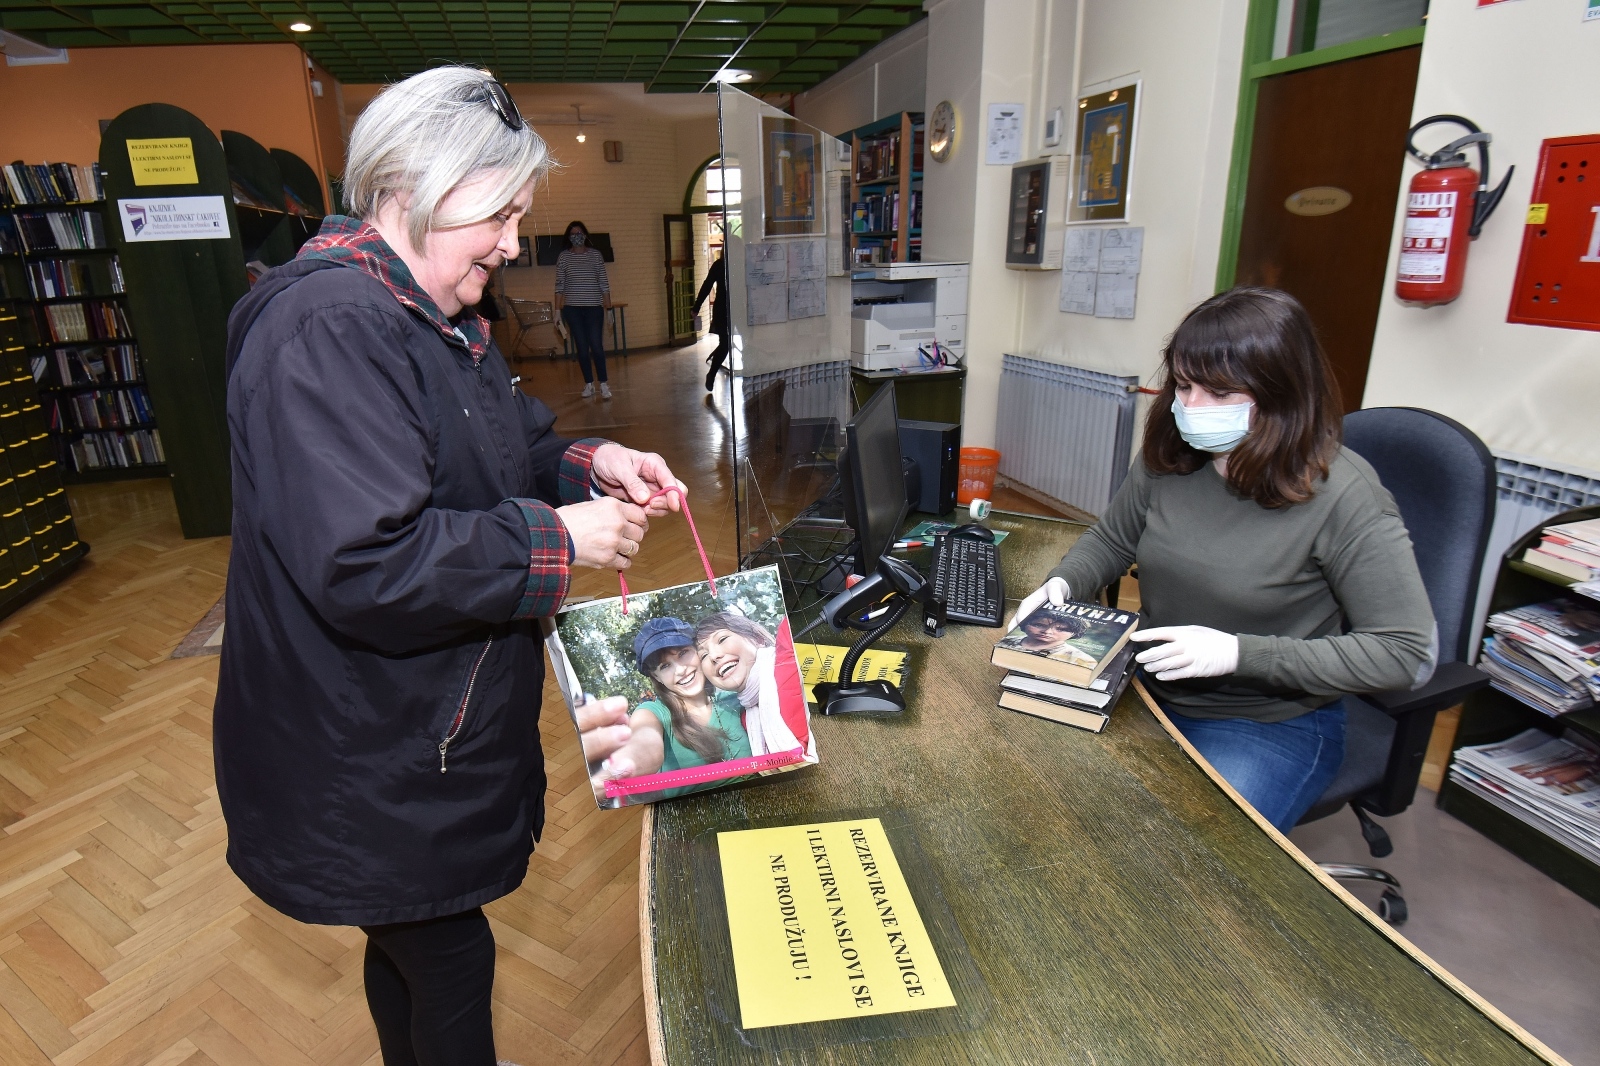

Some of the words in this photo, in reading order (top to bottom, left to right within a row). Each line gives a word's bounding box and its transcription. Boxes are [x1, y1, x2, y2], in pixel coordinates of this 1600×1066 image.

[770, 854, 787, 874] NE
[773, 876, 811, 972] PRODUŽUJU
[808, 836, 841, 906] LEKTIRNI
[829, 906, 866, 981] NASLOVI
[851, 984, 874, 1009] SE
[849, 828, 899, 928] REZERVIRANE
[886, 931, 926, 998] KNJIGE
